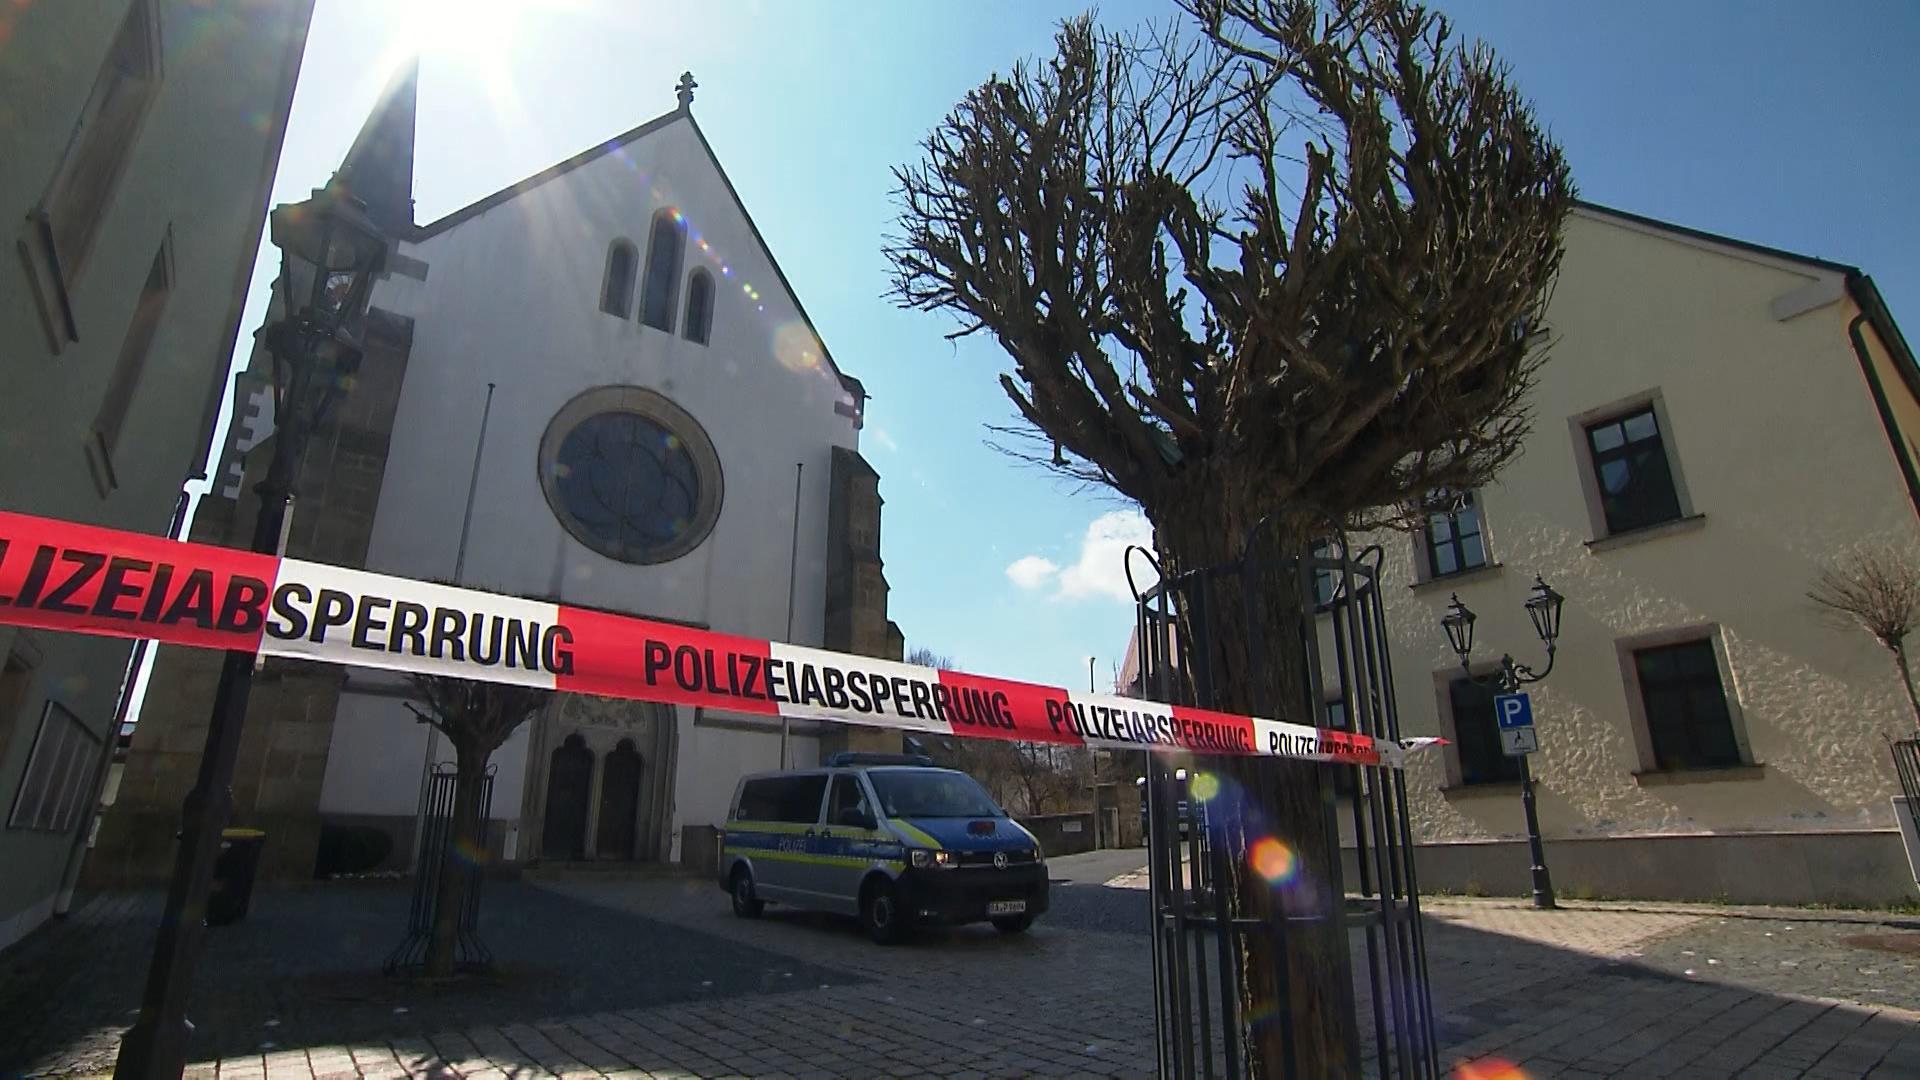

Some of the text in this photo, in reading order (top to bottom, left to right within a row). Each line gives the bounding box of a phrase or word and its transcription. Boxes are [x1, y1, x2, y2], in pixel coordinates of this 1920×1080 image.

[644, 639, 1015, 731] POLIZEIABSPERRUNG
[1045, 699, 1250, 753] POLIZEIABSPERRUNG
[1503, 698, 1522, 725] P
